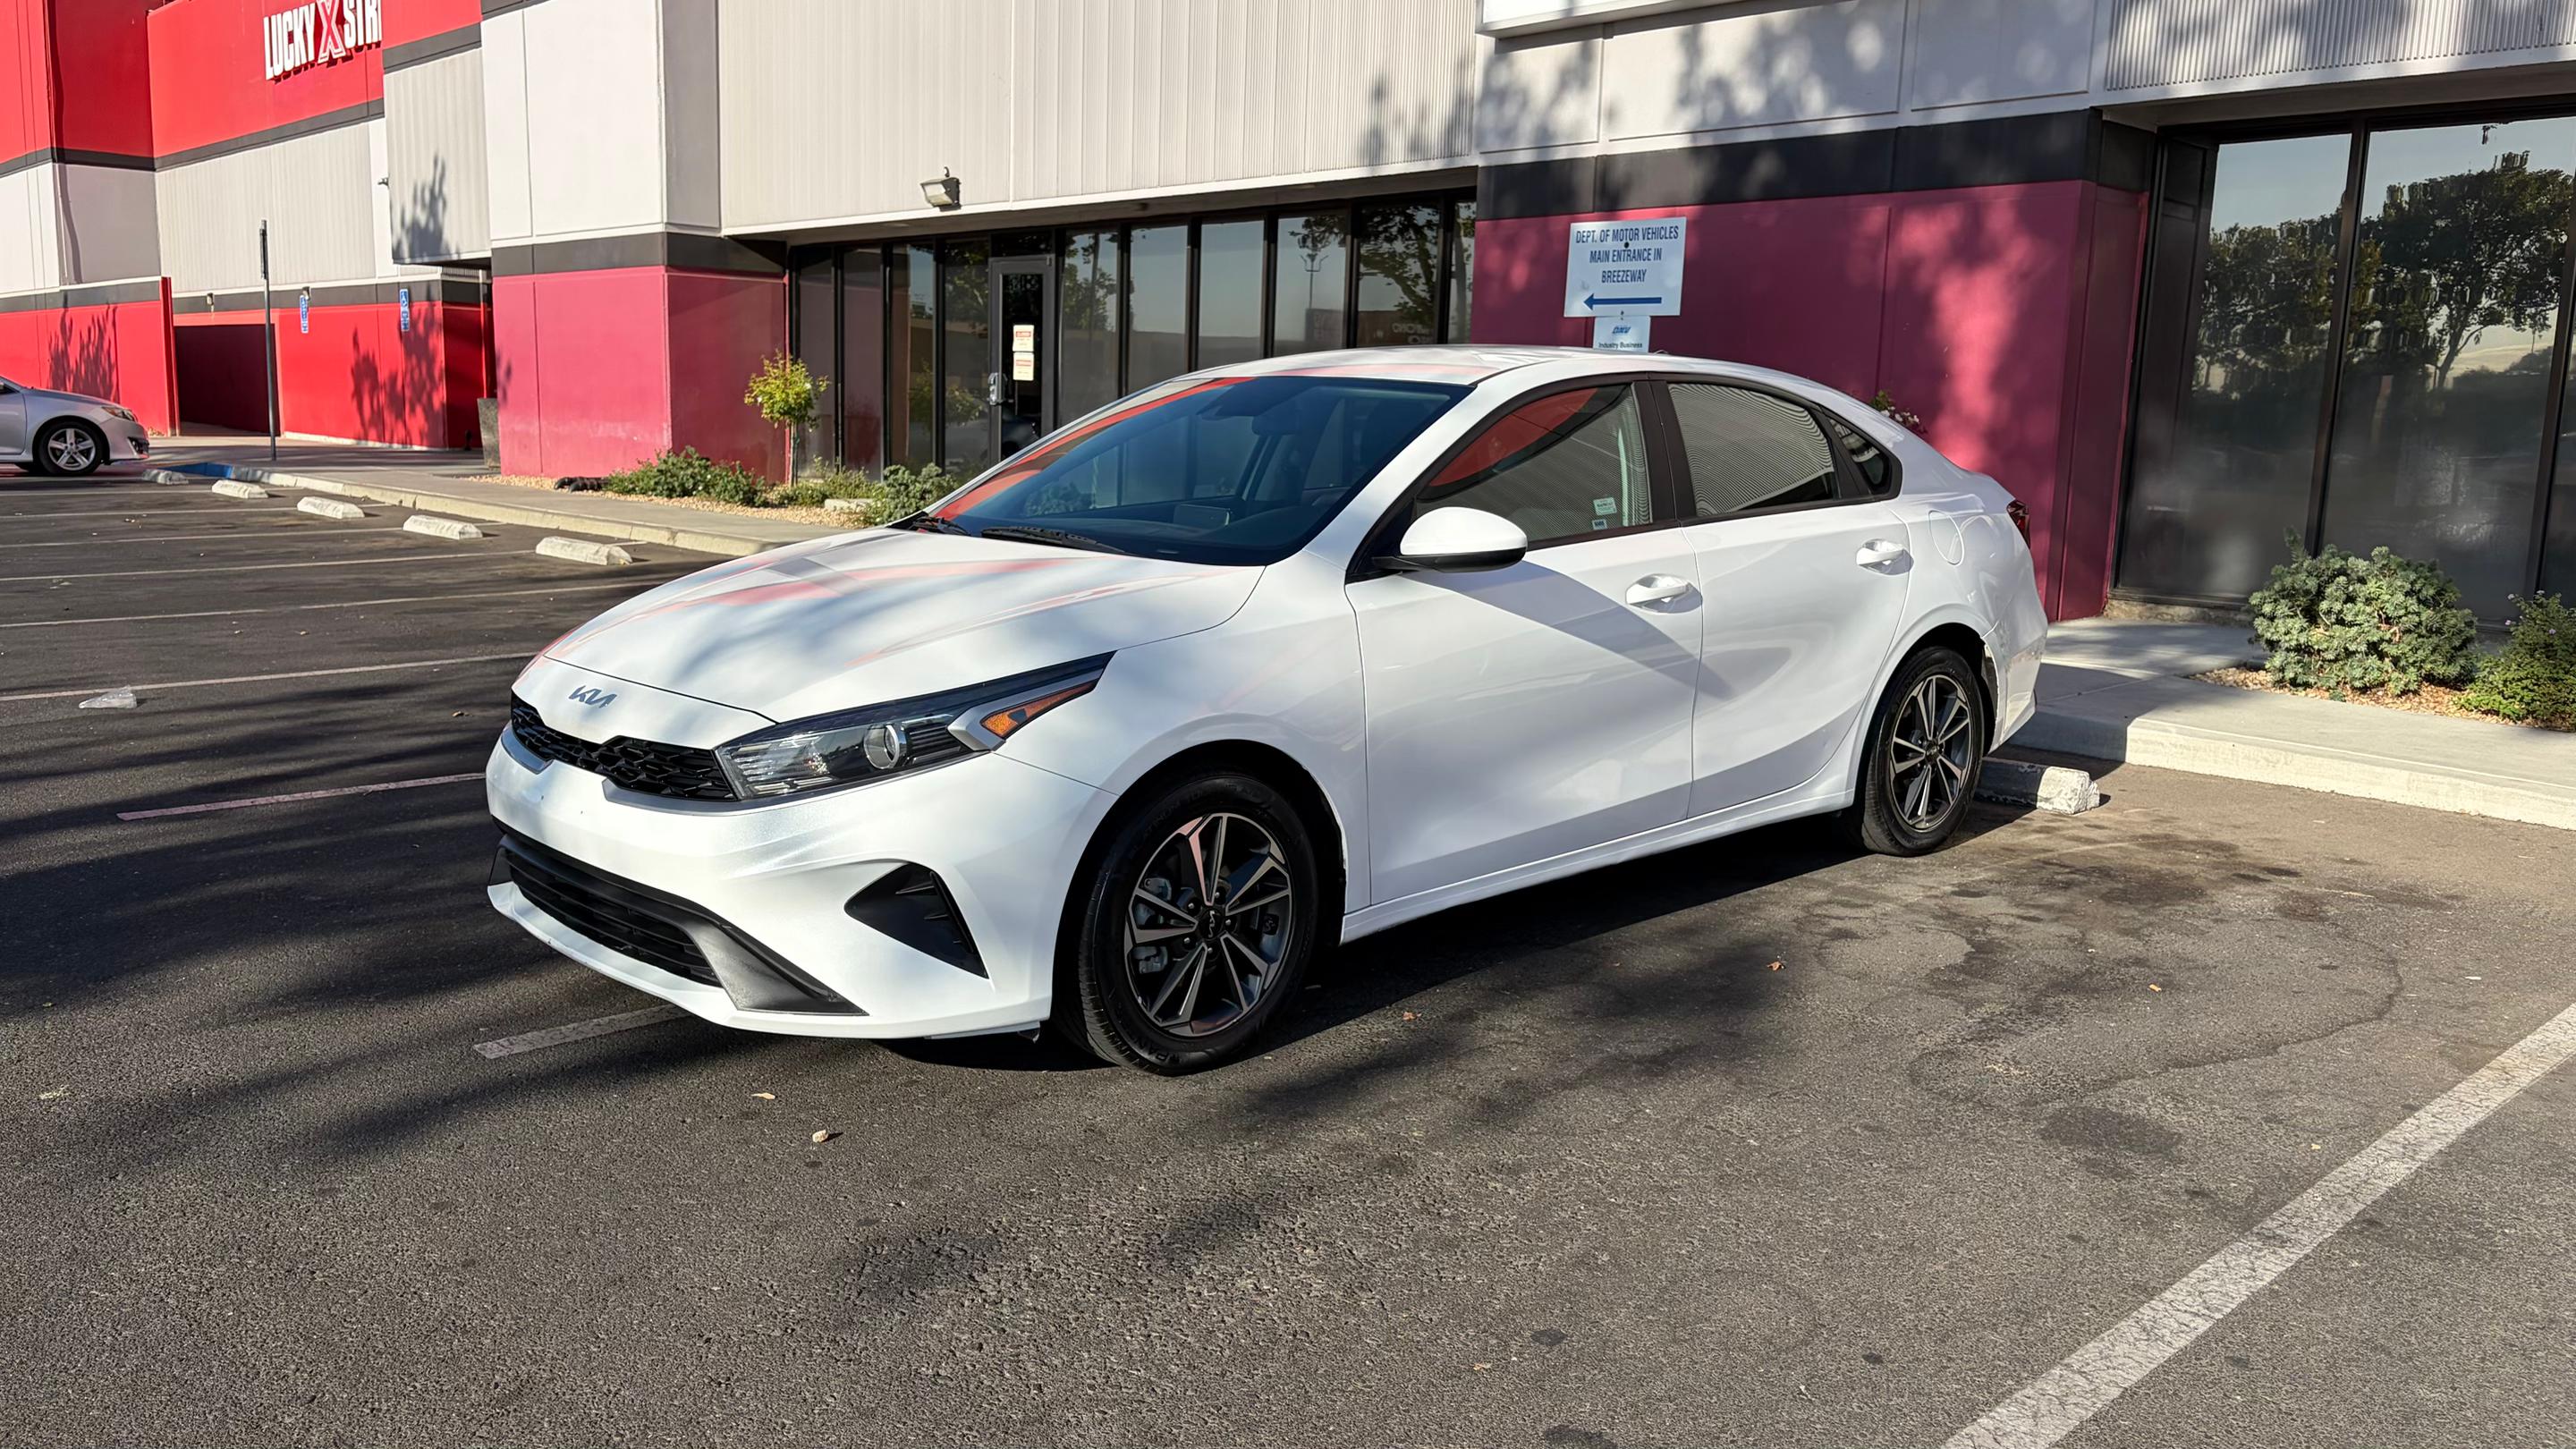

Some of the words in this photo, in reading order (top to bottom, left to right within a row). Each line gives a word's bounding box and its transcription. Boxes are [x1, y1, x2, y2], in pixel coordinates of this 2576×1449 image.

[264, 3, 316, 80] LUCKY
[1576, 230, 1597, 243] DEPT.
[1599, 230, 1610, 242] OF
[1612, 228, 1640, 242] MOTOR
[1642, 225, 1679, 241] VEHICLES
[1589, 250, 1610, 263] MAIN
[1612, 249, 1651, 262] ENTRANCE
[1654, 248, 1662, 260] IN
[1601, 269, 1647, 283] BREEZEWAY
